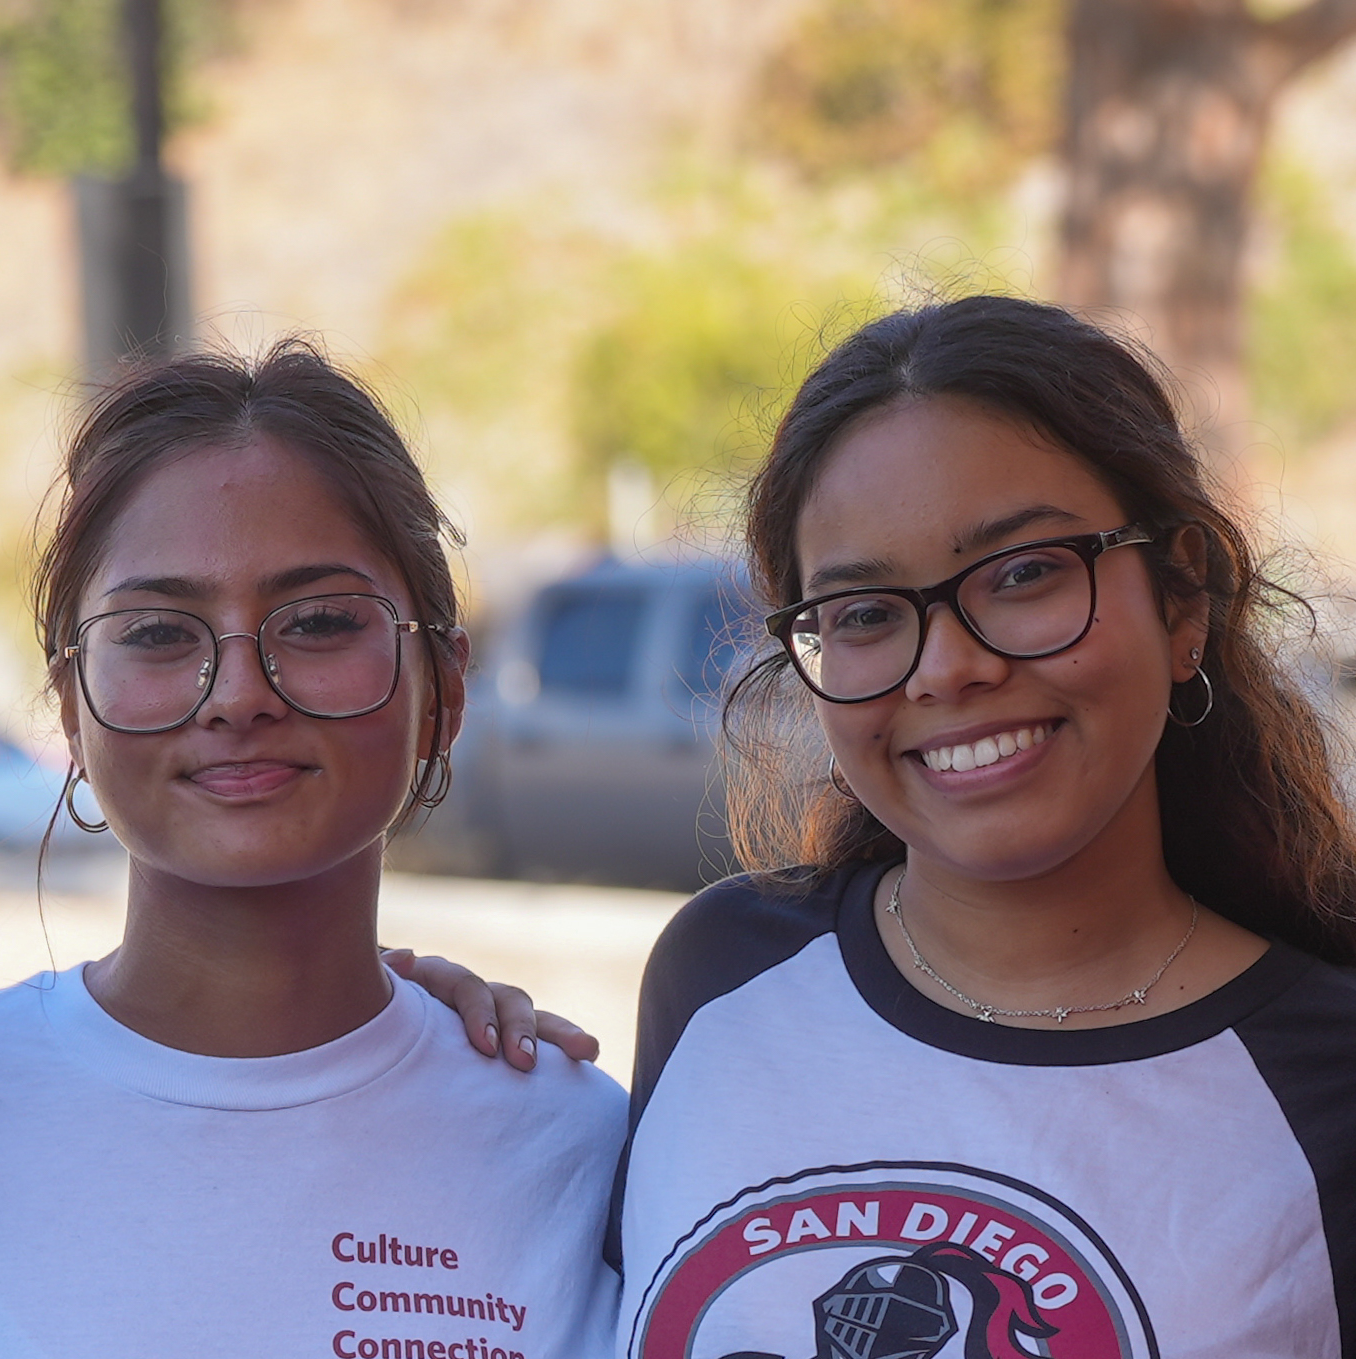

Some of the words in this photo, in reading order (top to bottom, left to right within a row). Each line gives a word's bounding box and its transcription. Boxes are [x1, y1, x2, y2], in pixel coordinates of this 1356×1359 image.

[331, 1231, 459, 1270] Culture
[743, 1200, 880, 1256] SAN
[900, 1201, 1079, 1310] DIEGO
[331, 1281, 527, 1332] Community
